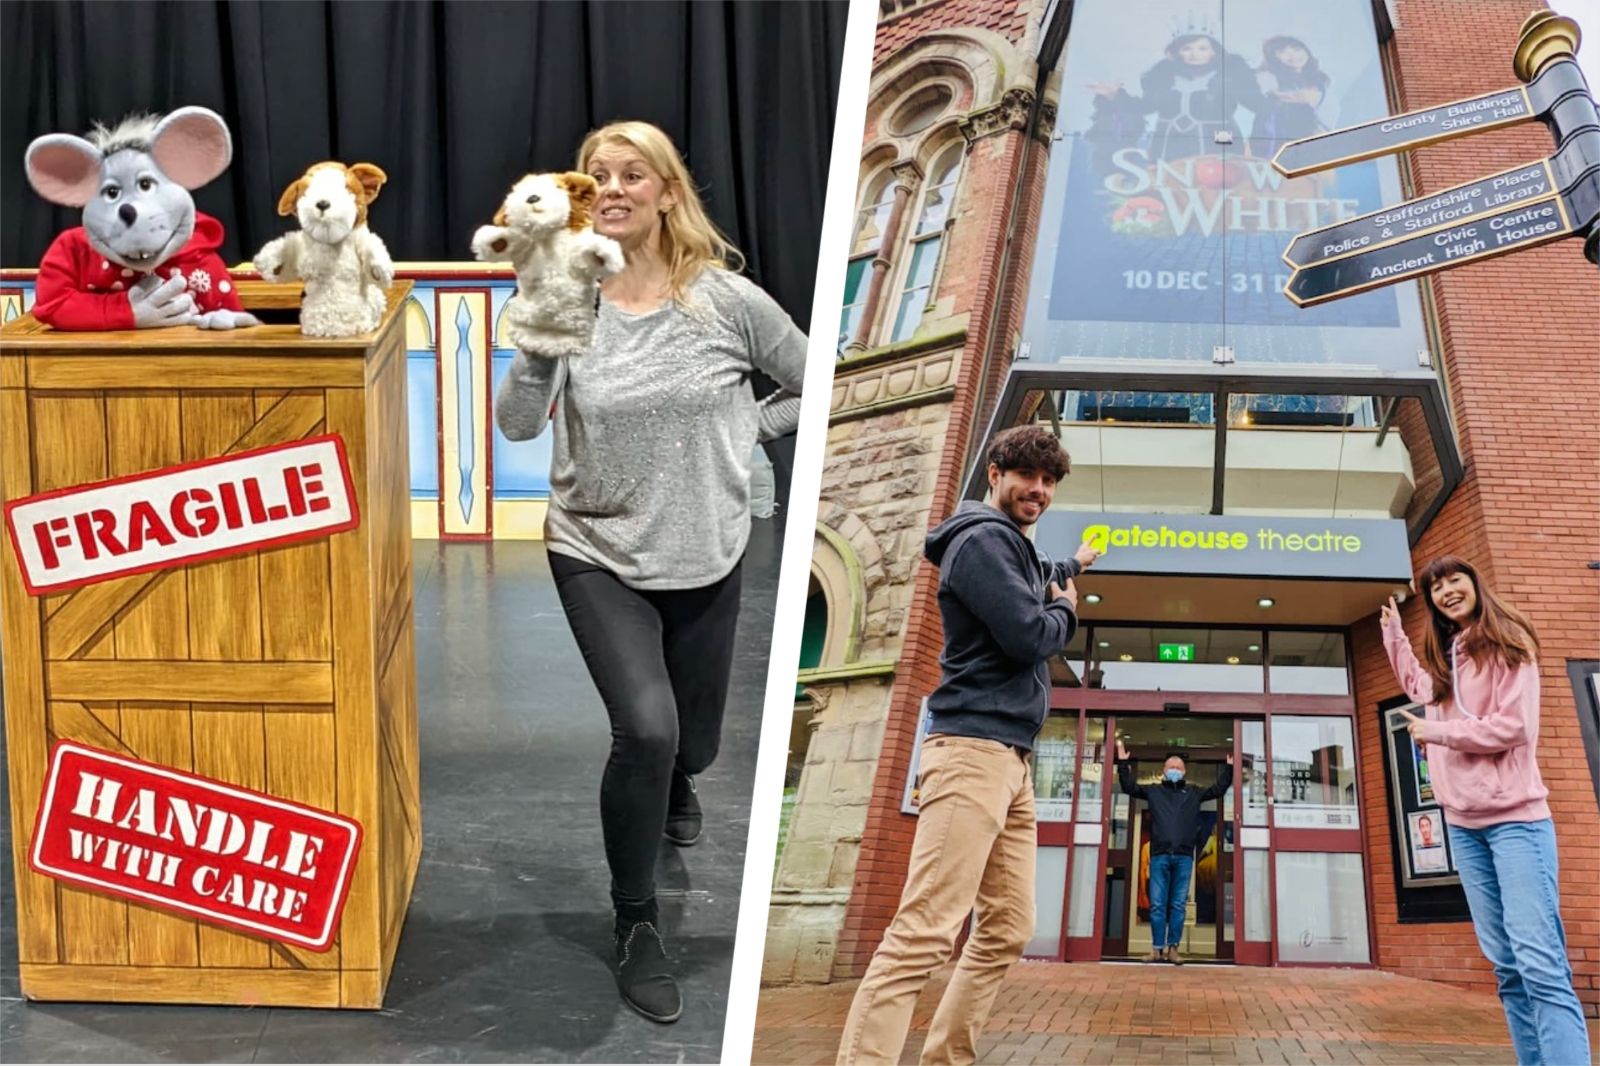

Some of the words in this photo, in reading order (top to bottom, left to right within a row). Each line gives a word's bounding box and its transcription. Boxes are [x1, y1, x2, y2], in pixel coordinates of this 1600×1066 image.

[1380, 113, 1436, 133] County
[1447, 93, 1521, 117] Buildings
[1441, 113, 1483, 131] Shire
[1493, 104, 1524, 119] Hall
[1152, 187, 1360, 238] WHITE
[1323, 234, 1370, 256] Police
[1381, 227, 1394, 239] &
[1404, 203, 1473, 232] Stafford
[1484, 180, 1546, 207] Library
[1374, 187, 1482, 227] Staffordshire
[1493, 168, 1542, 190] Place
[1370, 252, 1435, 279] Ancient
[1445, 238, 1486, 259] High
[1496, 220, 1558, 244] House
[1434, 226, 1477, 247] Civic
[1489, 206, 1554, 230] Centre
[1122, 269, 1152, 289] 10
[1157, 270, 1208, 290] DEC
[1231, 274, 1263, 292] 31
[33, 463, 331, 570] FRAGILE
[1257, 528, 1362, 553] theatre
[71, 771, 325, 880] HANDLE
[68, 828, 183, 888] WITH
[191, 865, 308, 923] CARE
